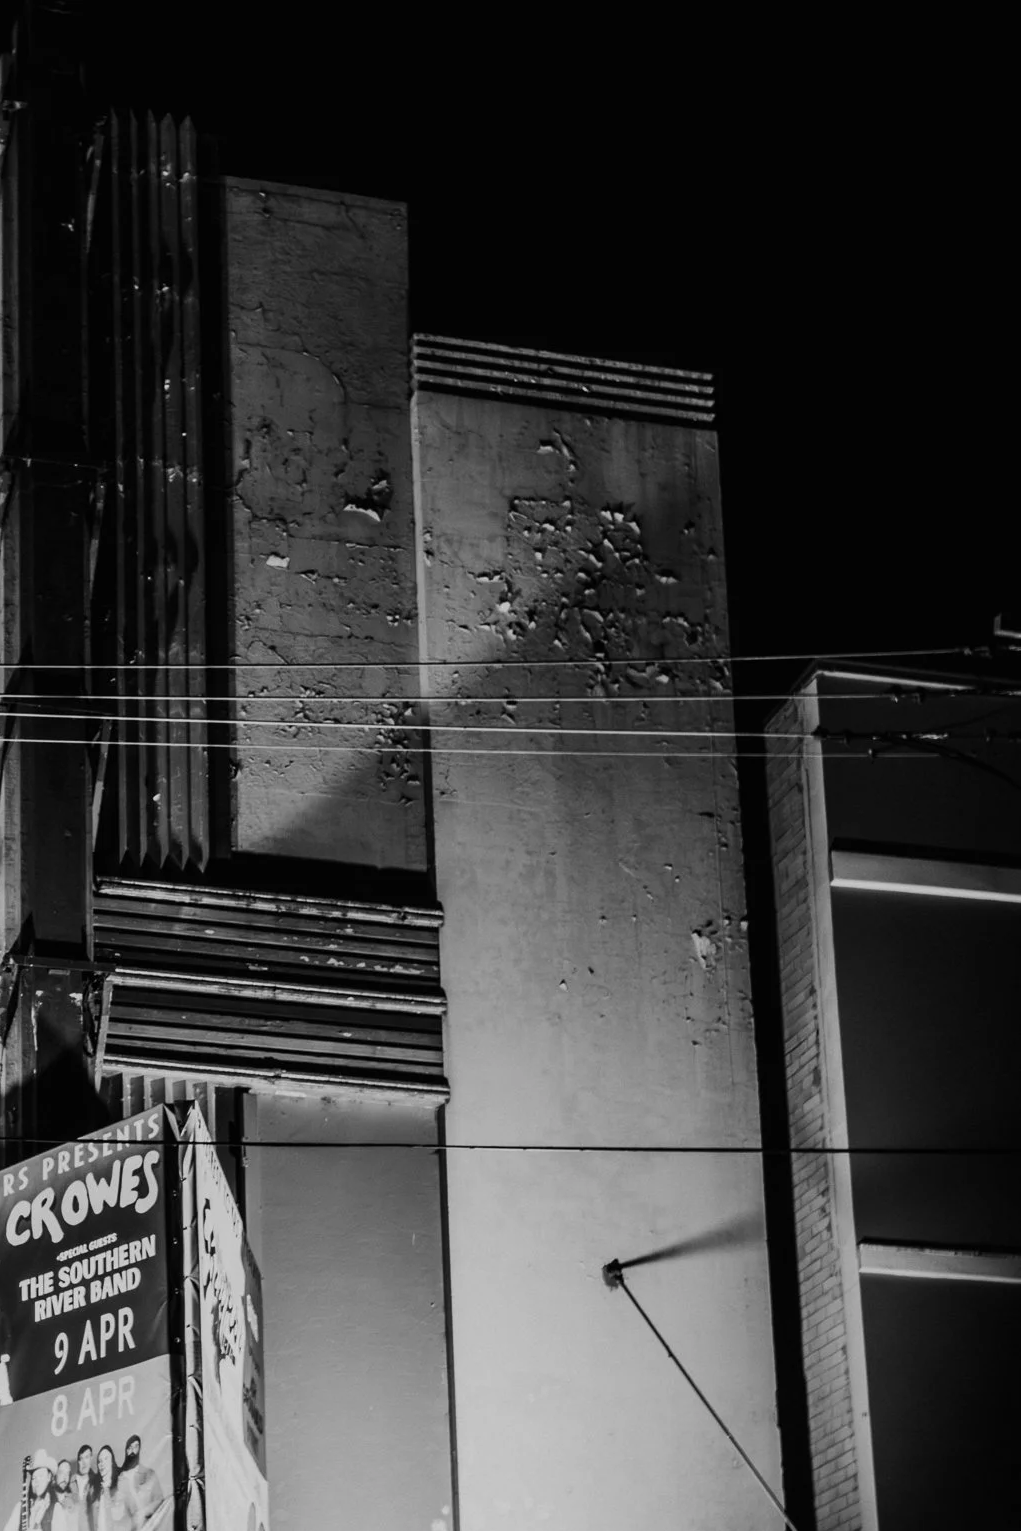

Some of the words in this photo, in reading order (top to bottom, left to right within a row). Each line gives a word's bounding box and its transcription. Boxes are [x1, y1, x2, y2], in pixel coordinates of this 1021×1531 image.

[42, 1113, 160, 1181] PRESENTS
[6, 1150, 160, 1246] CROWES
[19, 1271, 54, 1301] THE
[58, 1234, 156, 1288] SOUTHERN
[34, 1286, 86, 1322] RIVER
[90, 1267, 141, 1303] BAND
[54, 1332, 69, 1375] 9
[78, 1306, 136, 1365] APR
[51, 1394, 68, 1437] 8
[77, 1375, 135, 1431] APR
